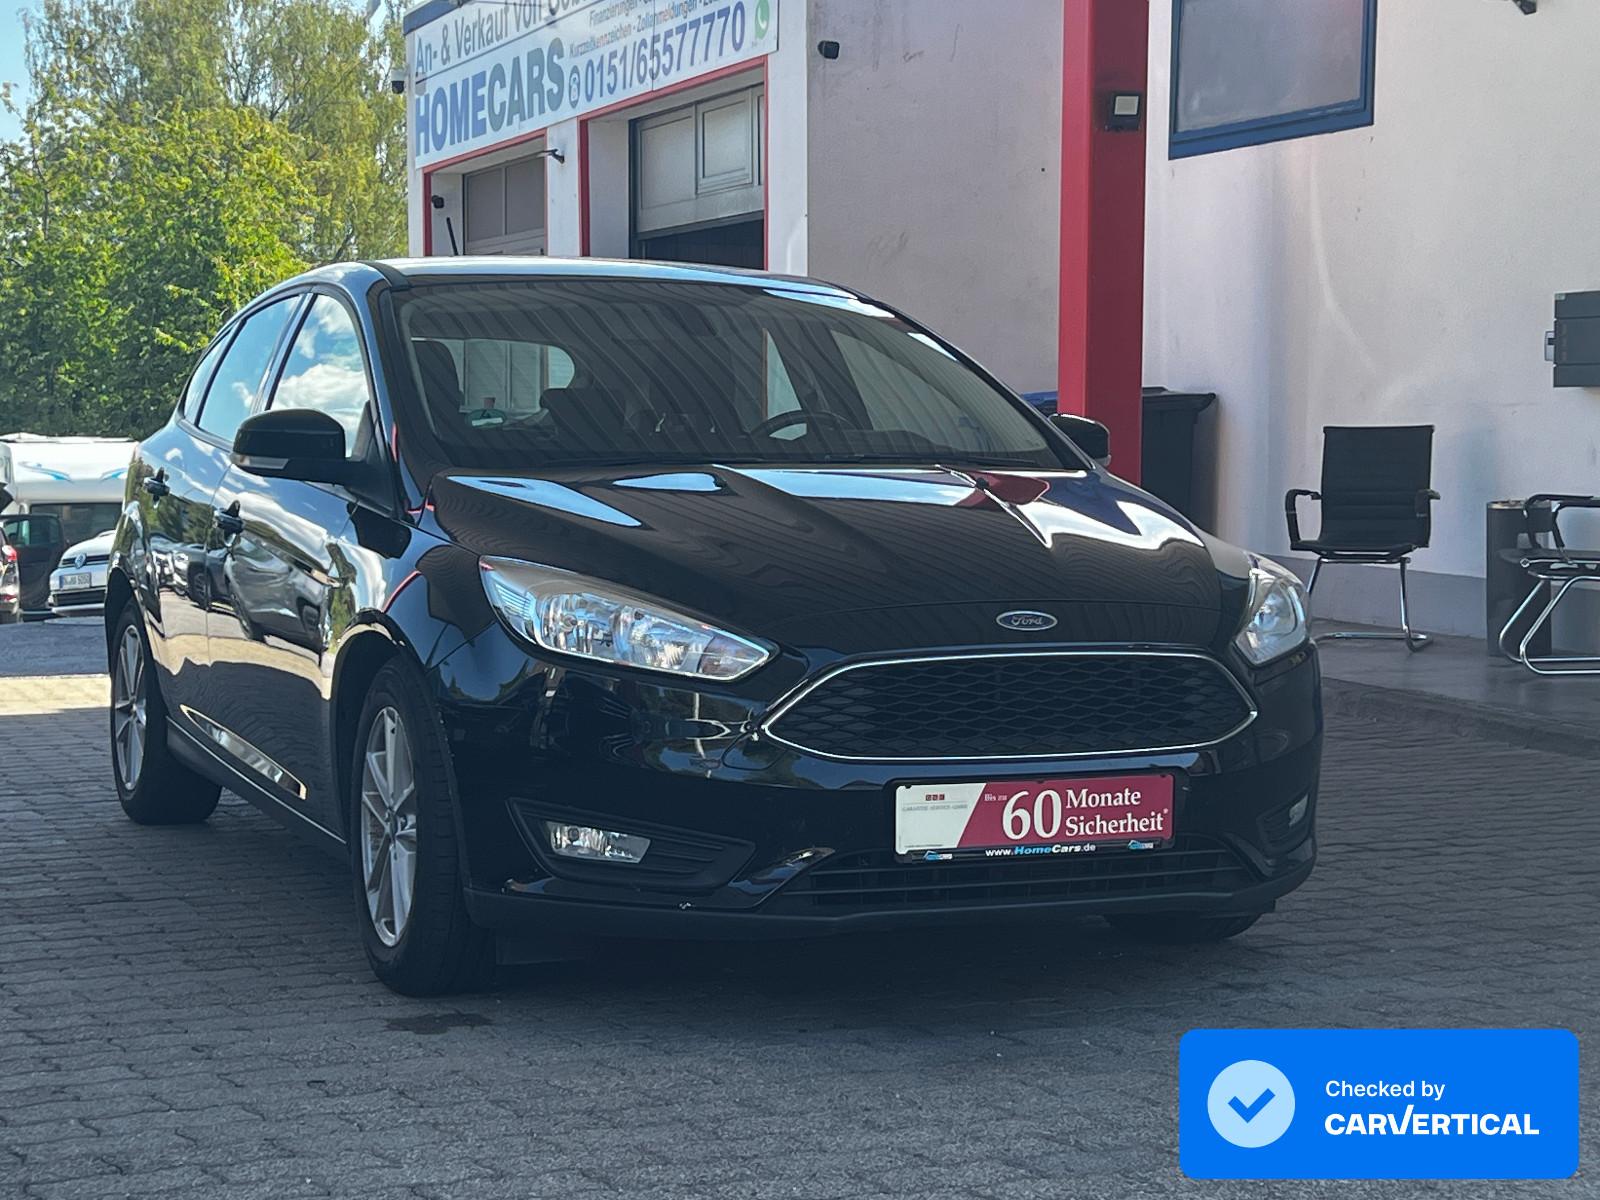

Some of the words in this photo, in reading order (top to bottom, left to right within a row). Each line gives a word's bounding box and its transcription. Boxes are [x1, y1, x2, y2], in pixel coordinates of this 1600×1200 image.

[416, 35, 437, 74] An-
[441, 23, 450, 65] &
[455, 5, 510, 58] Verkauf
[514, 0, 542, 32] von
[585, 1, 745, 103] 0151/65577770
[416, 37, 564, 156] HOMECARS
[985, 844, 1096, 857] www.HomeCars.de
[1003, 790, 1061, 840] 60
[1066, 788, 1142, 809] Monate
